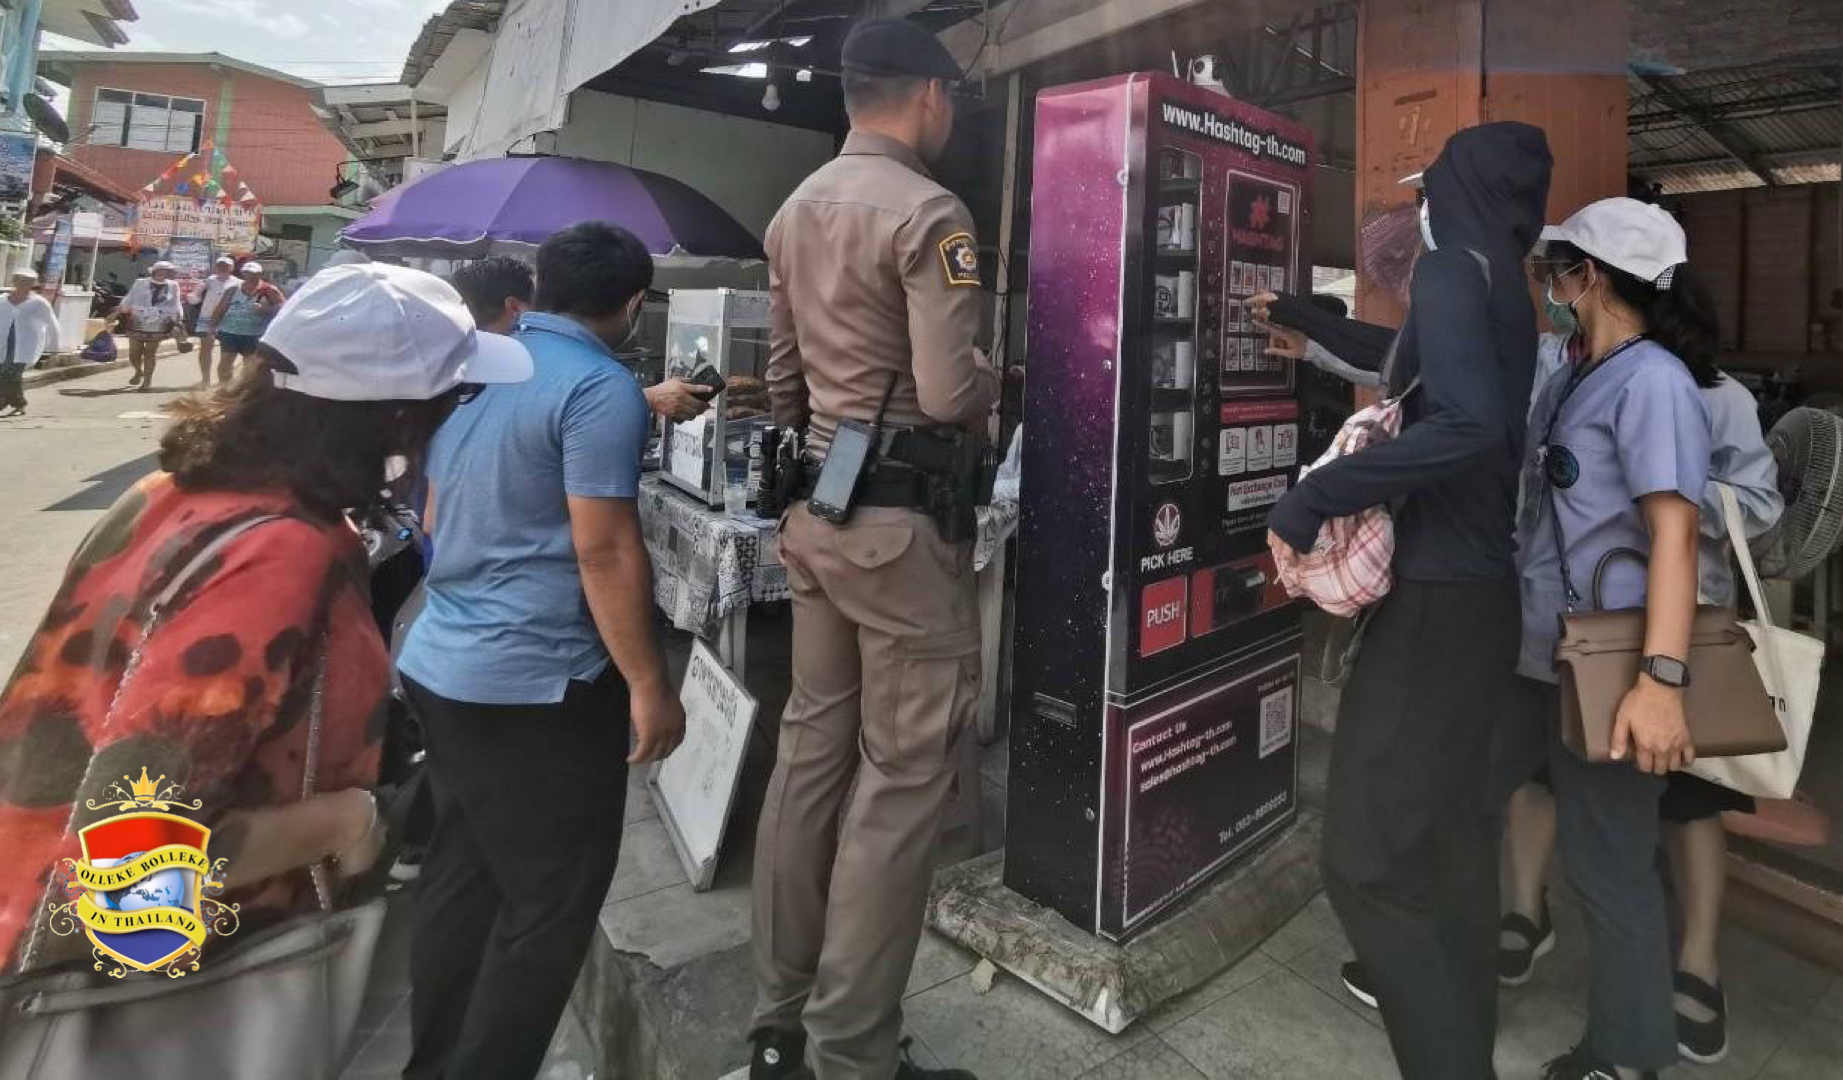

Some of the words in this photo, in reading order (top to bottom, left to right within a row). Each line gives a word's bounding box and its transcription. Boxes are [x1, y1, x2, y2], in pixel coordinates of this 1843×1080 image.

[1162, 103, 1306, 165] www.Hashtag-th.com
[1141, 553, 1164, 573] PICK
[1167, 547, 1194, 565] HERE
[1147, 602, 1180, 628] PUSH
[1132, 728, 1172, 753] Contact
[1175, 721, 1187, 733] Us
